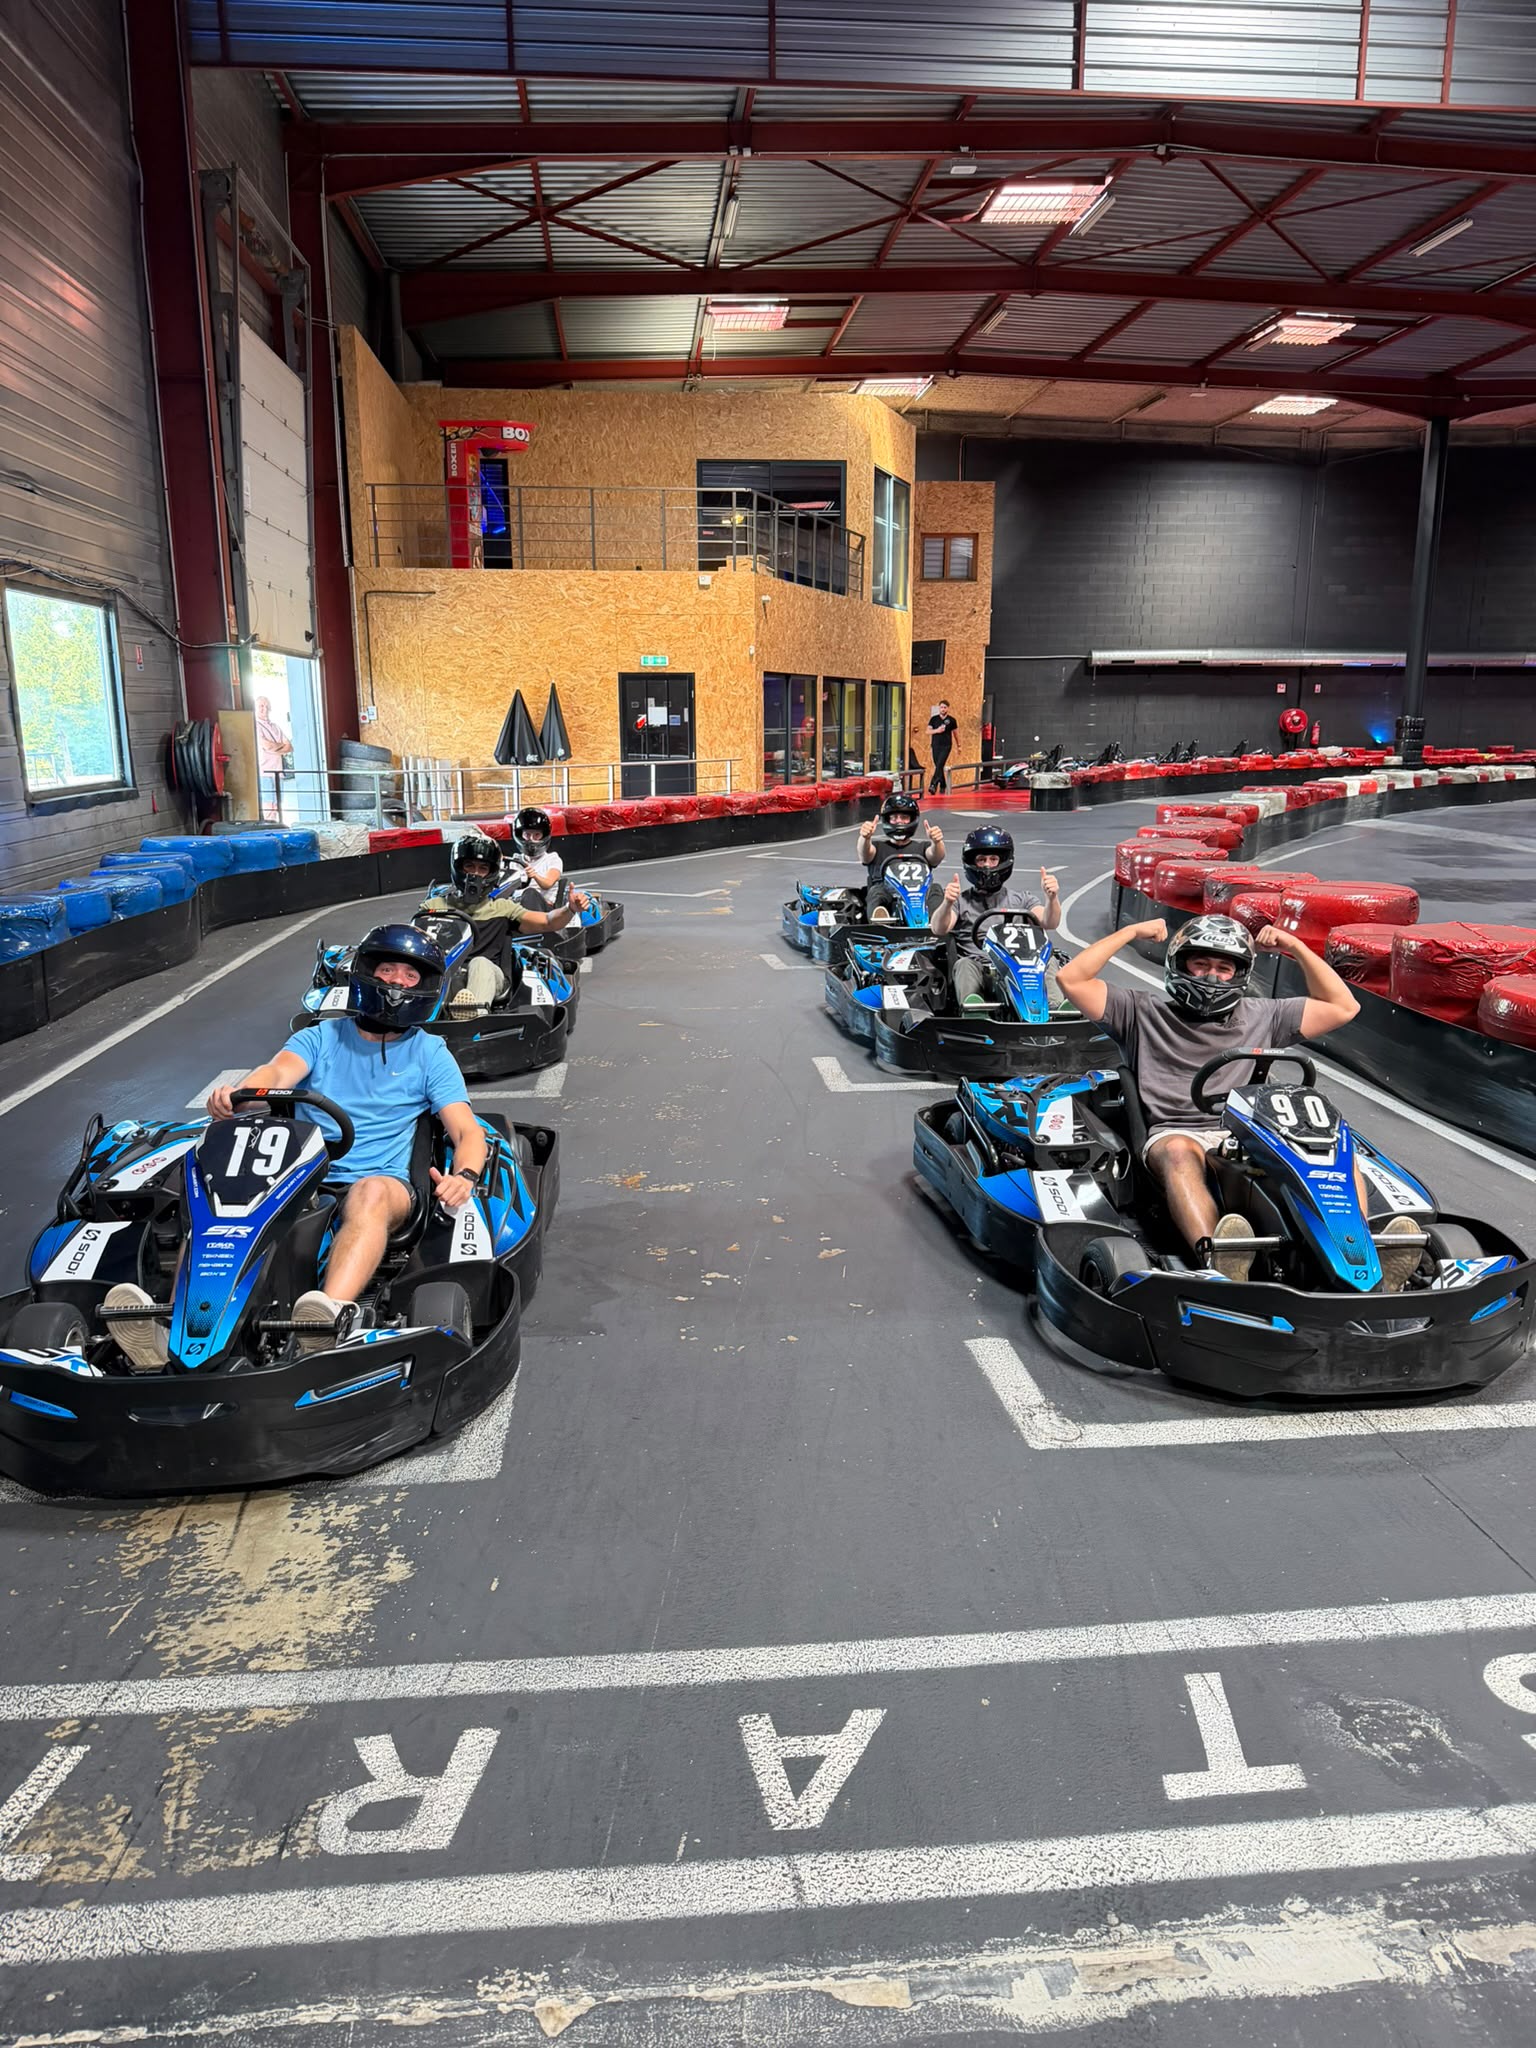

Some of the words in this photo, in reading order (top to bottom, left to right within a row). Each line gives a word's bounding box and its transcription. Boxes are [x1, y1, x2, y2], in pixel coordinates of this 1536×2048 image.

[450, 443, 458, 477] BOXER
[898, 864, 923, 880] 22
[1003, 926, 1036, 950] 21
[1270, 1094, 1331, 1128] 90
[225, 1126, 290, 1177] 19
[201, 1225, 255, 1239] SR
